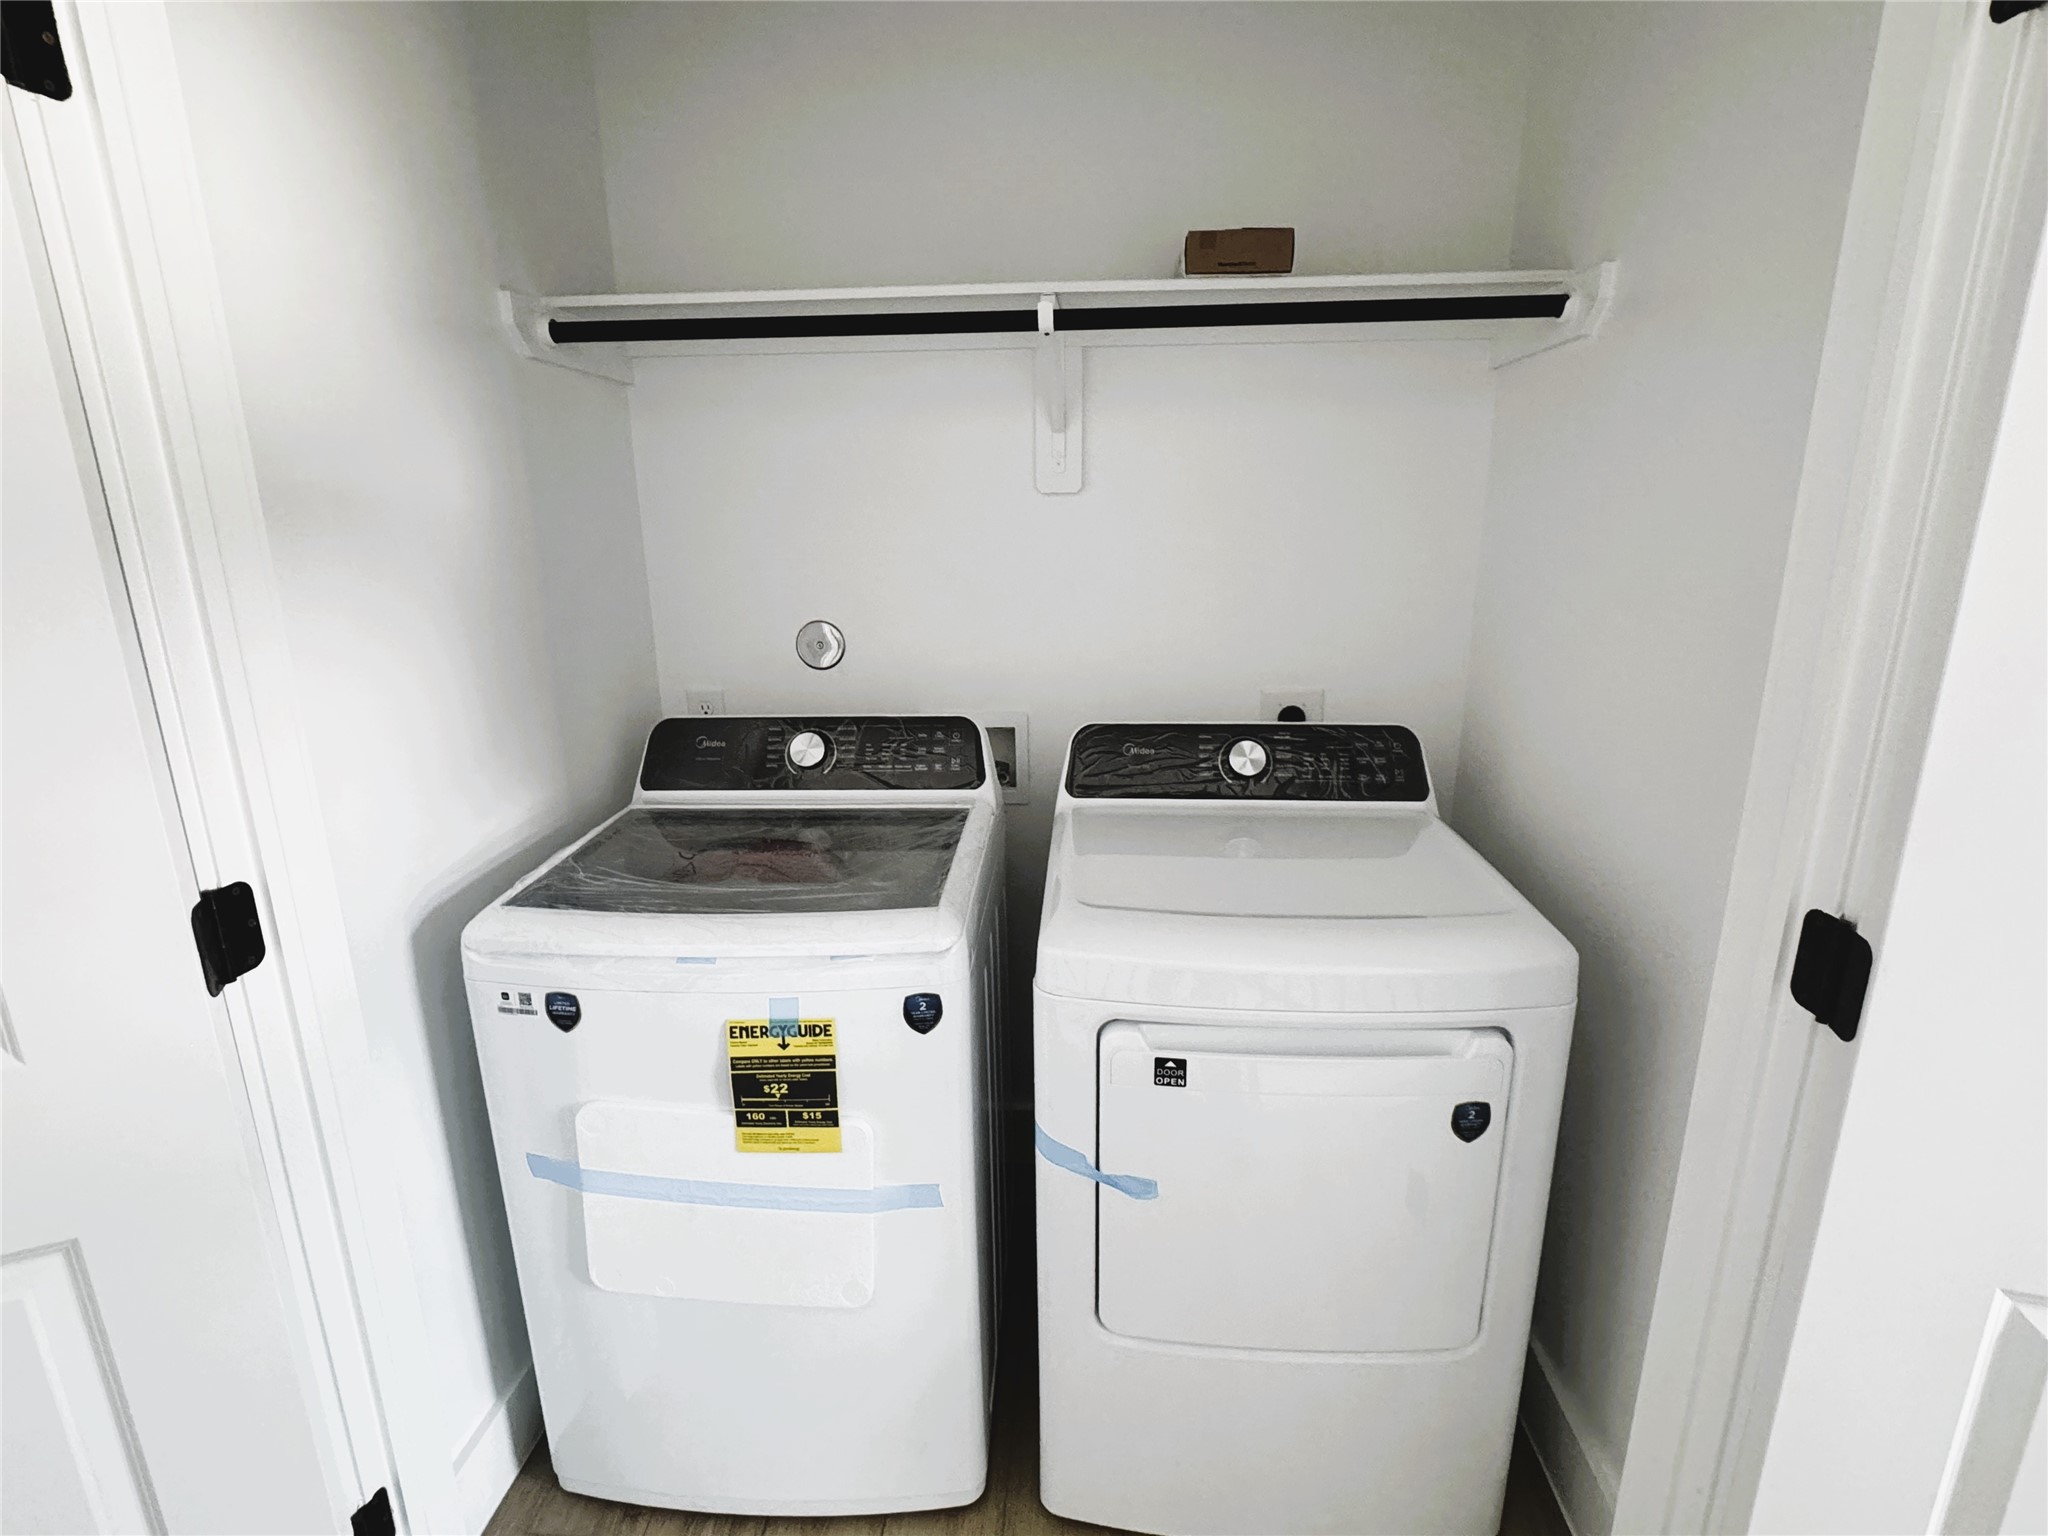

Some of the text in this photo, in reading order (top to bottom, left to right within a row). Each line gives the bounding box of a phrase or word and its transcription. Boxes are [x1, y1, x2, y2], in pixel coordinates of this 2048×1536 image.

[698, 737, 726, 748] Midea
[1125, 745, 1155, 755] Midea
[919, 1002, 927, 1011] 2
[729, 1024, 833, 1039] ENERGYGUIDE
[1156, 1068, 1184, 1077] DOOR
[1155, 1077, 1185, 1086] OPEN
[763, 1083, 789, 1094] $22
[746, 1112, 766, 1120] 160
[802, 1111, 823, 1120] $15
[1467, 1110, 1476, 1119] 2
